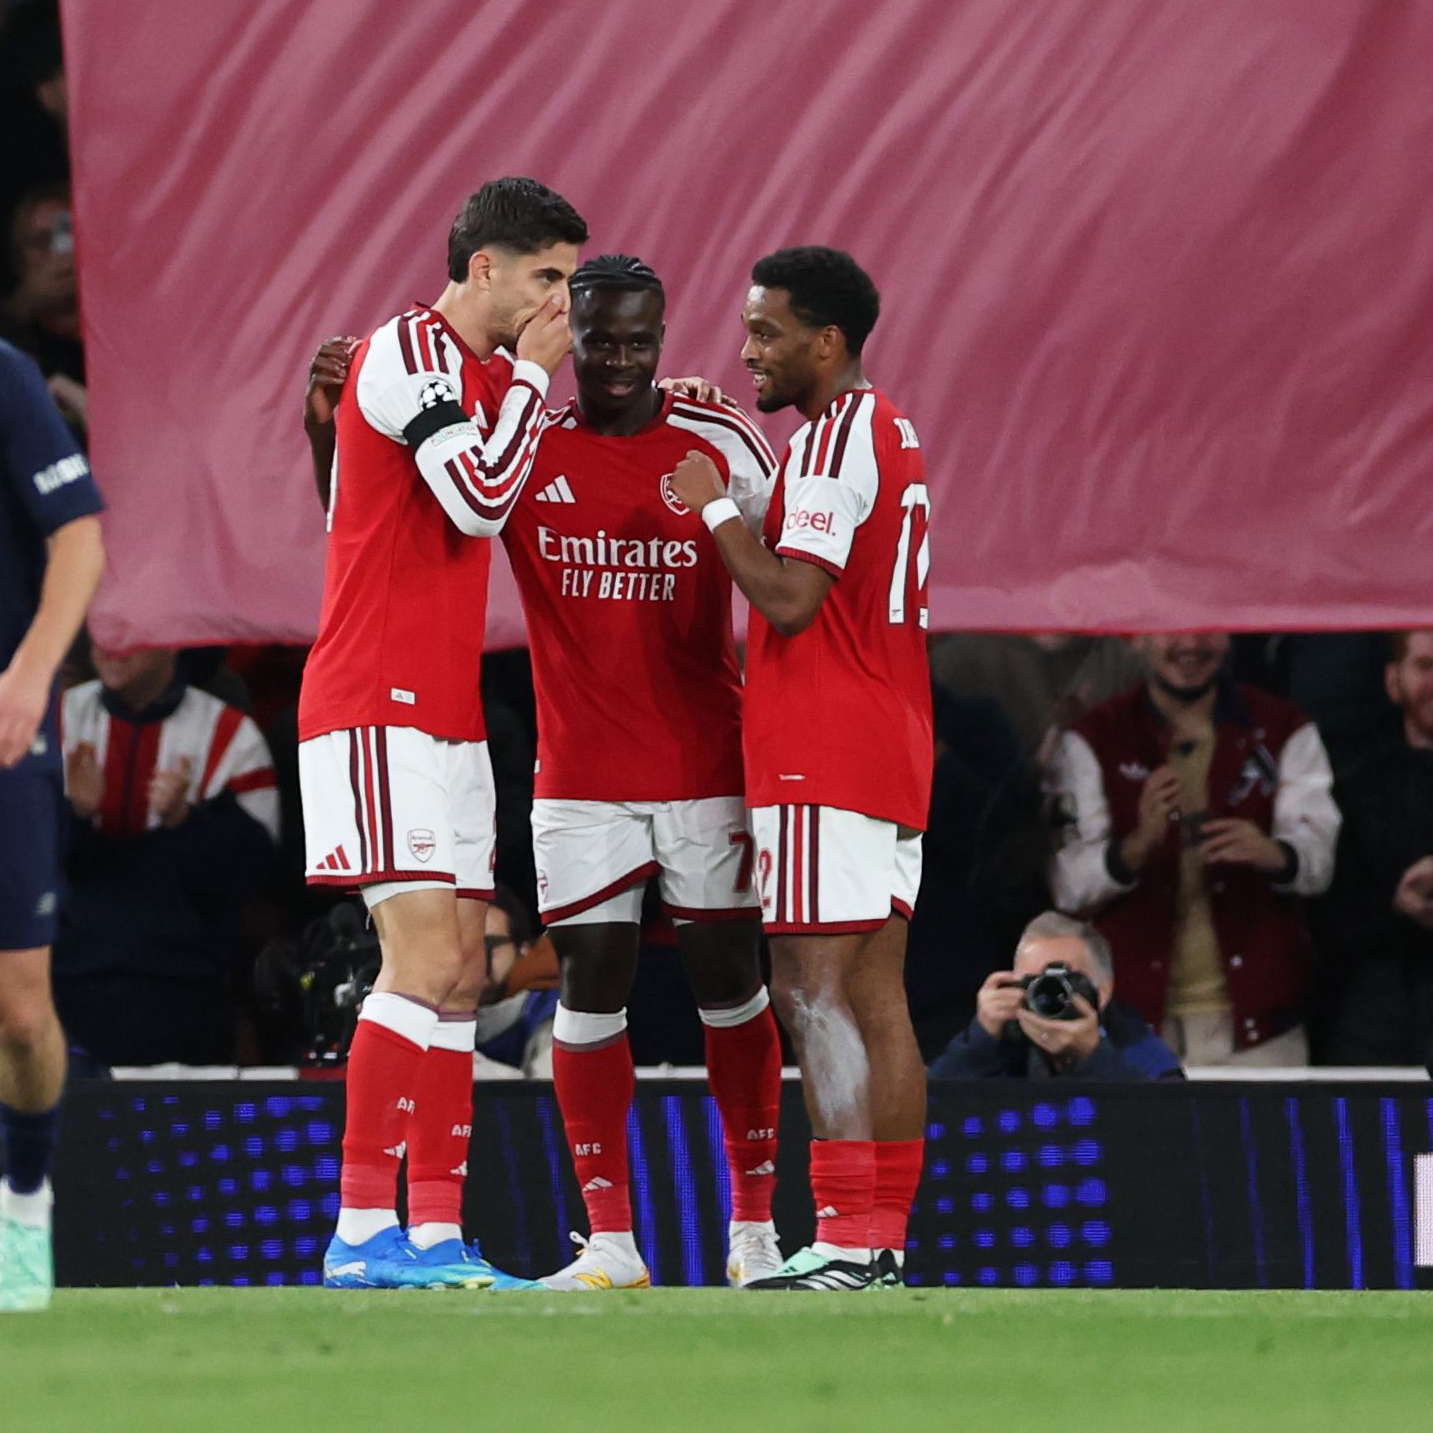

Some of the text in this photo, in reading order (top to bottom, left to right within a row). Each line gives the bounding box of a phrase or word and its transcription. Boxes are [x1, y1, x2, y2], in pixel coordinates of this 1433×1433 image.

[786, 506, 836, 537] deel.
[537, 525, 698, 568] Emirates
[561, 568, 676, 601] FLY BETTER
[728, 829, 757, 894] 7
